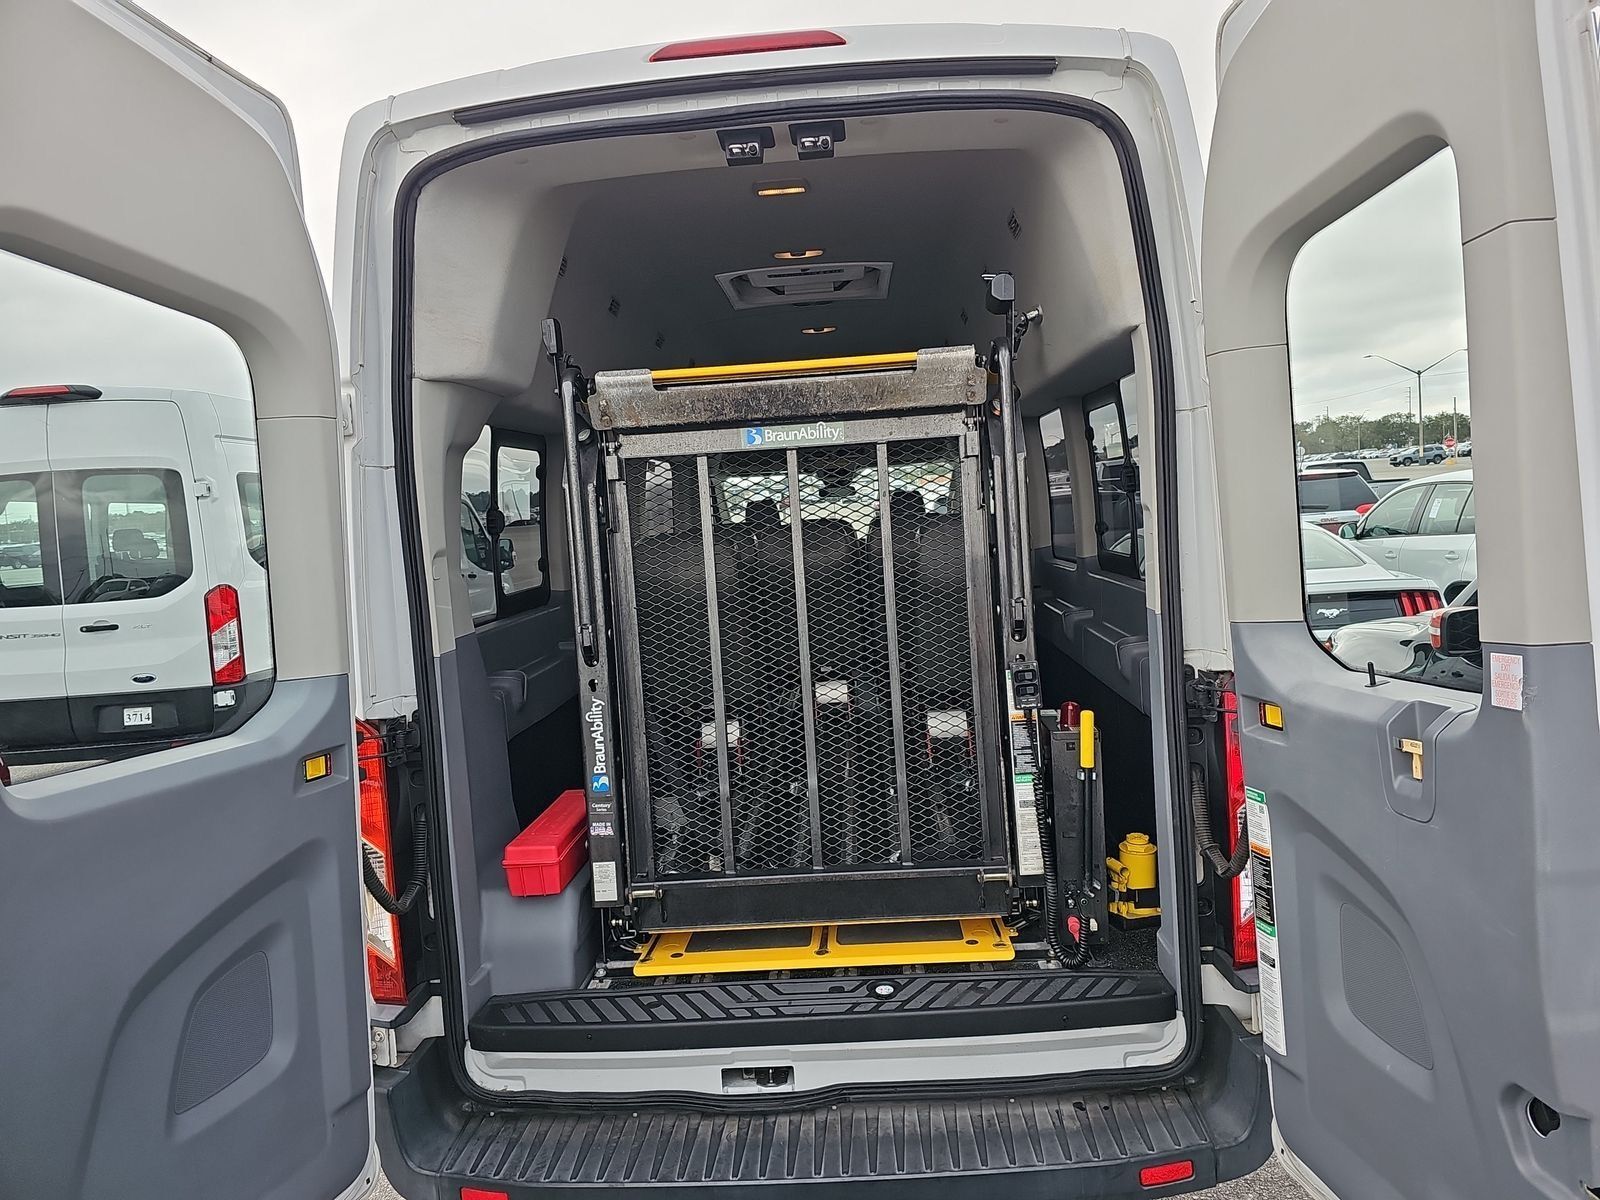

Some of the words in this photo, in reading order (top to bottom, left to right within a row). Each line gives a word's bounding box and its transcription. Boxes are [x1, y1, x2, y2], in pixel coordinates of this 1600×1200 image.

[764, 421, 841, 442] BraunAbility
[1492, 655, 1520, 664] EMERGENCY
[1500, 664, 1511, 672] EXIT
[125, 713, 151, 724] 3714
[585, 696, 606, 774] BraunAbility
[590, 826, 614, 835] USA
